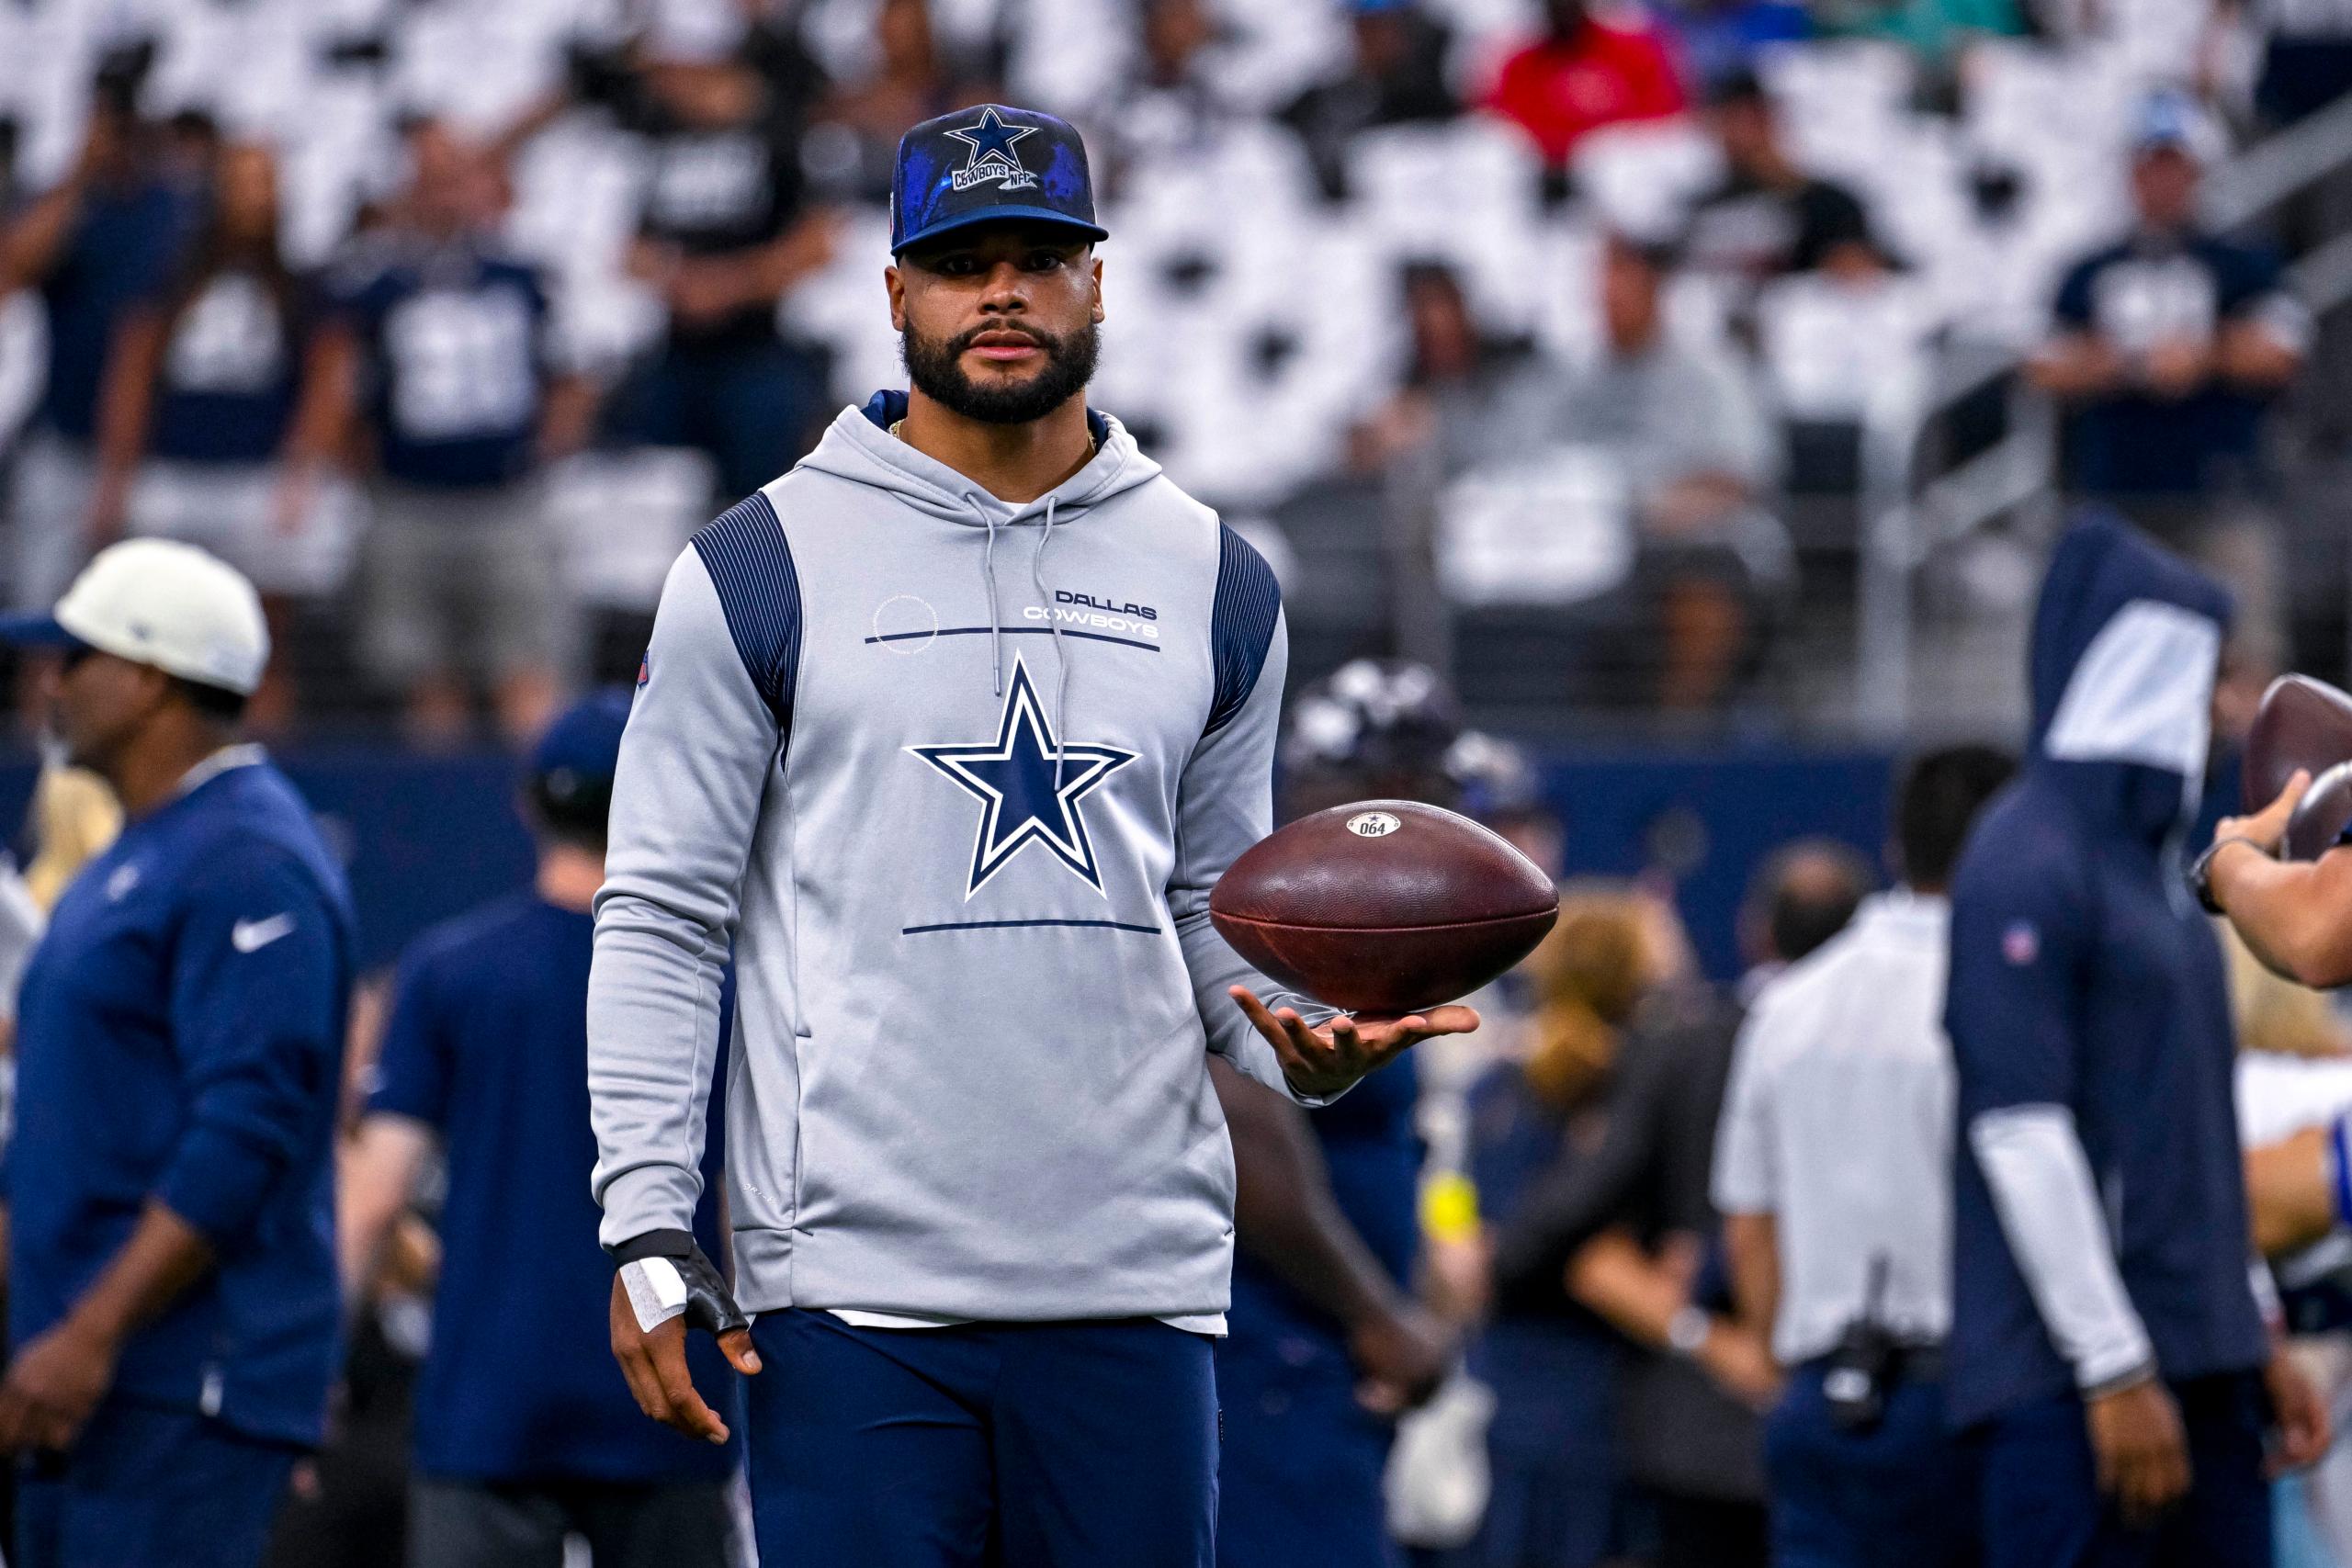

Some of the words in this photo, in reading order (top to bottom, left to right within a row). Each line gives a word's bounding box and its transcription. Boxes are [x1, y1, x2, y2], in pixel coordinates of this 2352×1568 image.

[955, 164, 1006, 187] COWBOYS
[1011, 174, 1030, 186] NFC
[1056, 590, 1158, 621] DALLAS
[1023, 606, 1159, 638] COWBOYS
[1360, 822, 1385, 835] 064
